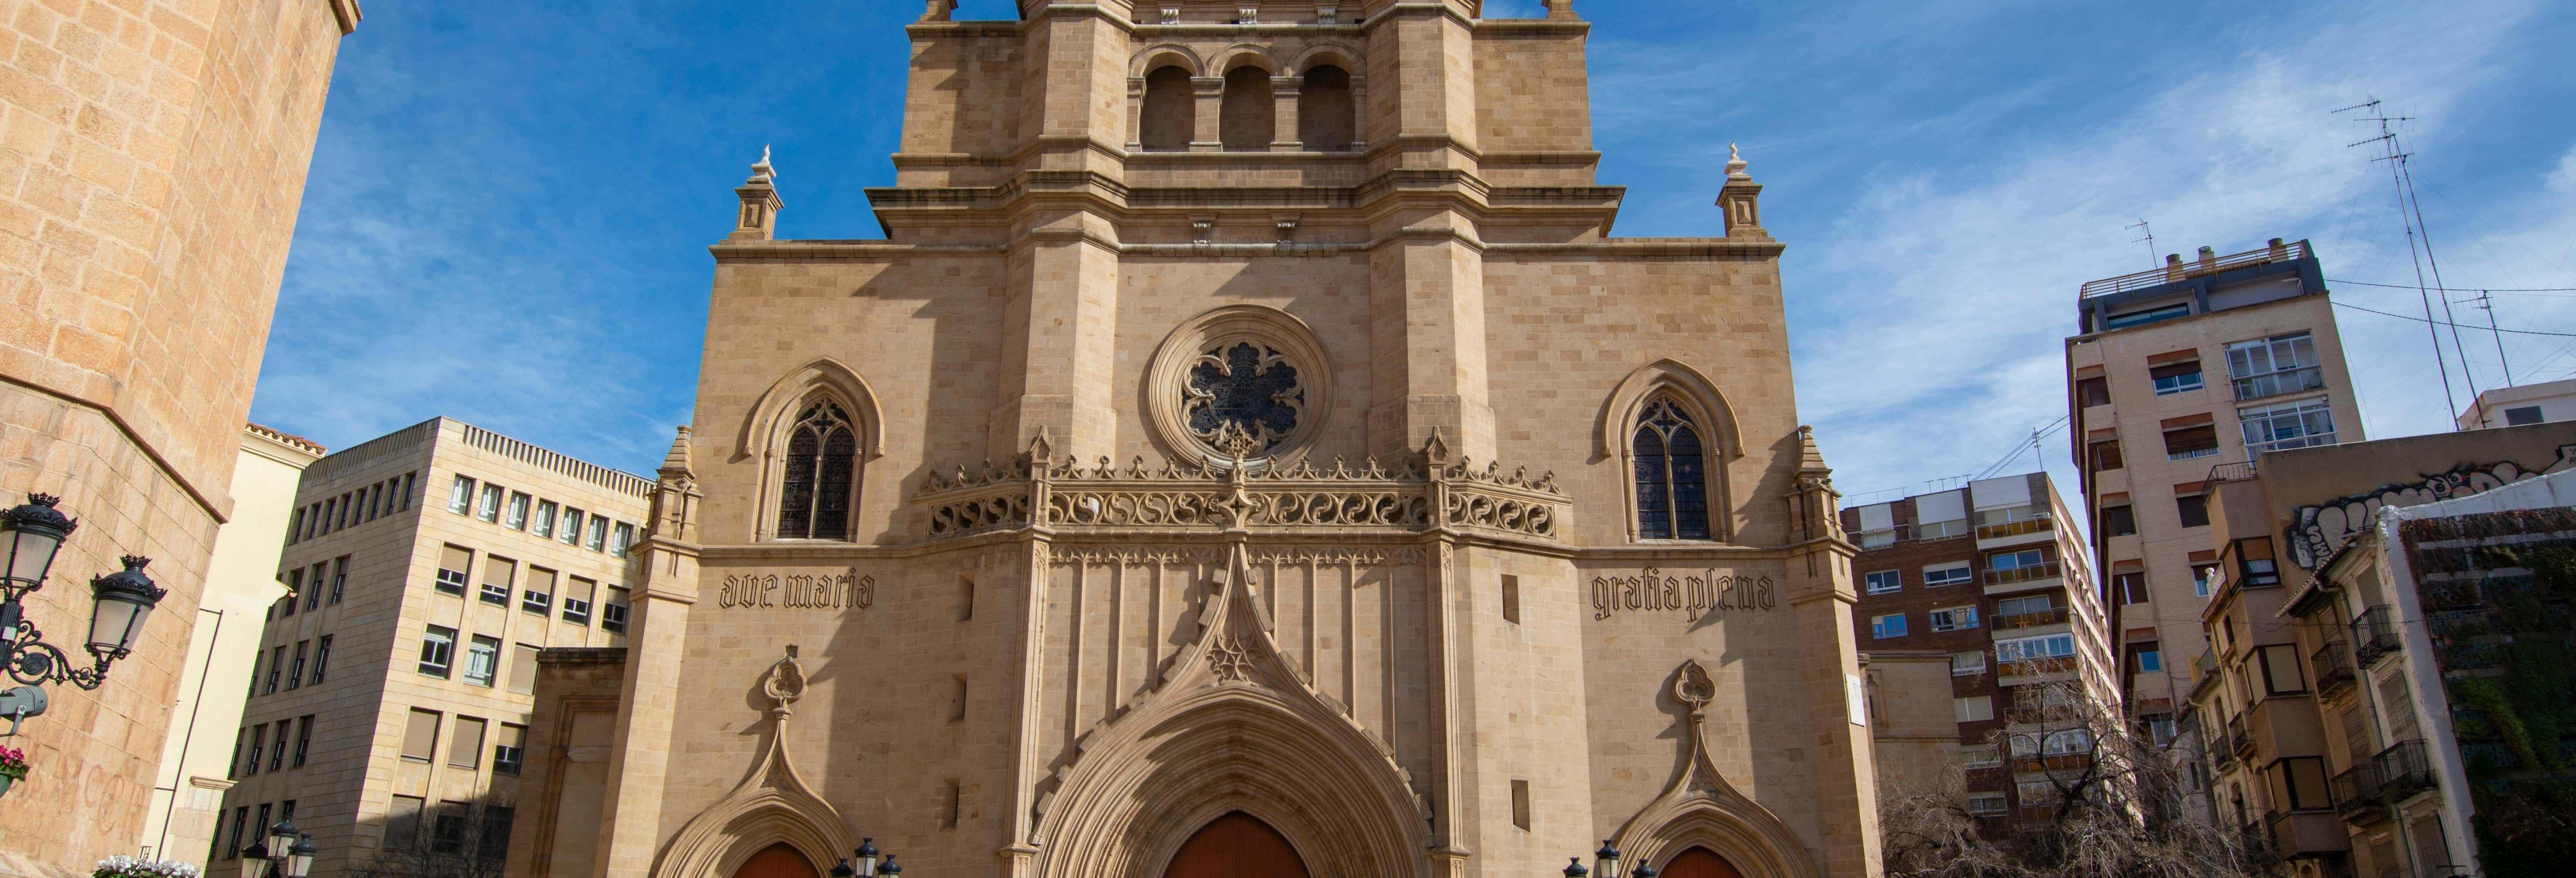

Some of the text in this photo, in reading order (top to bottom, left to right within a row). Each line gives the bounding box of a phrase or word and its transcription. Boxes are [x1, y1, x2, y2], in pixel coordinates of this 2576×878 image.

[719, 567, 875, 609] ave maria
[1685, 567, 1776, 623] plena
